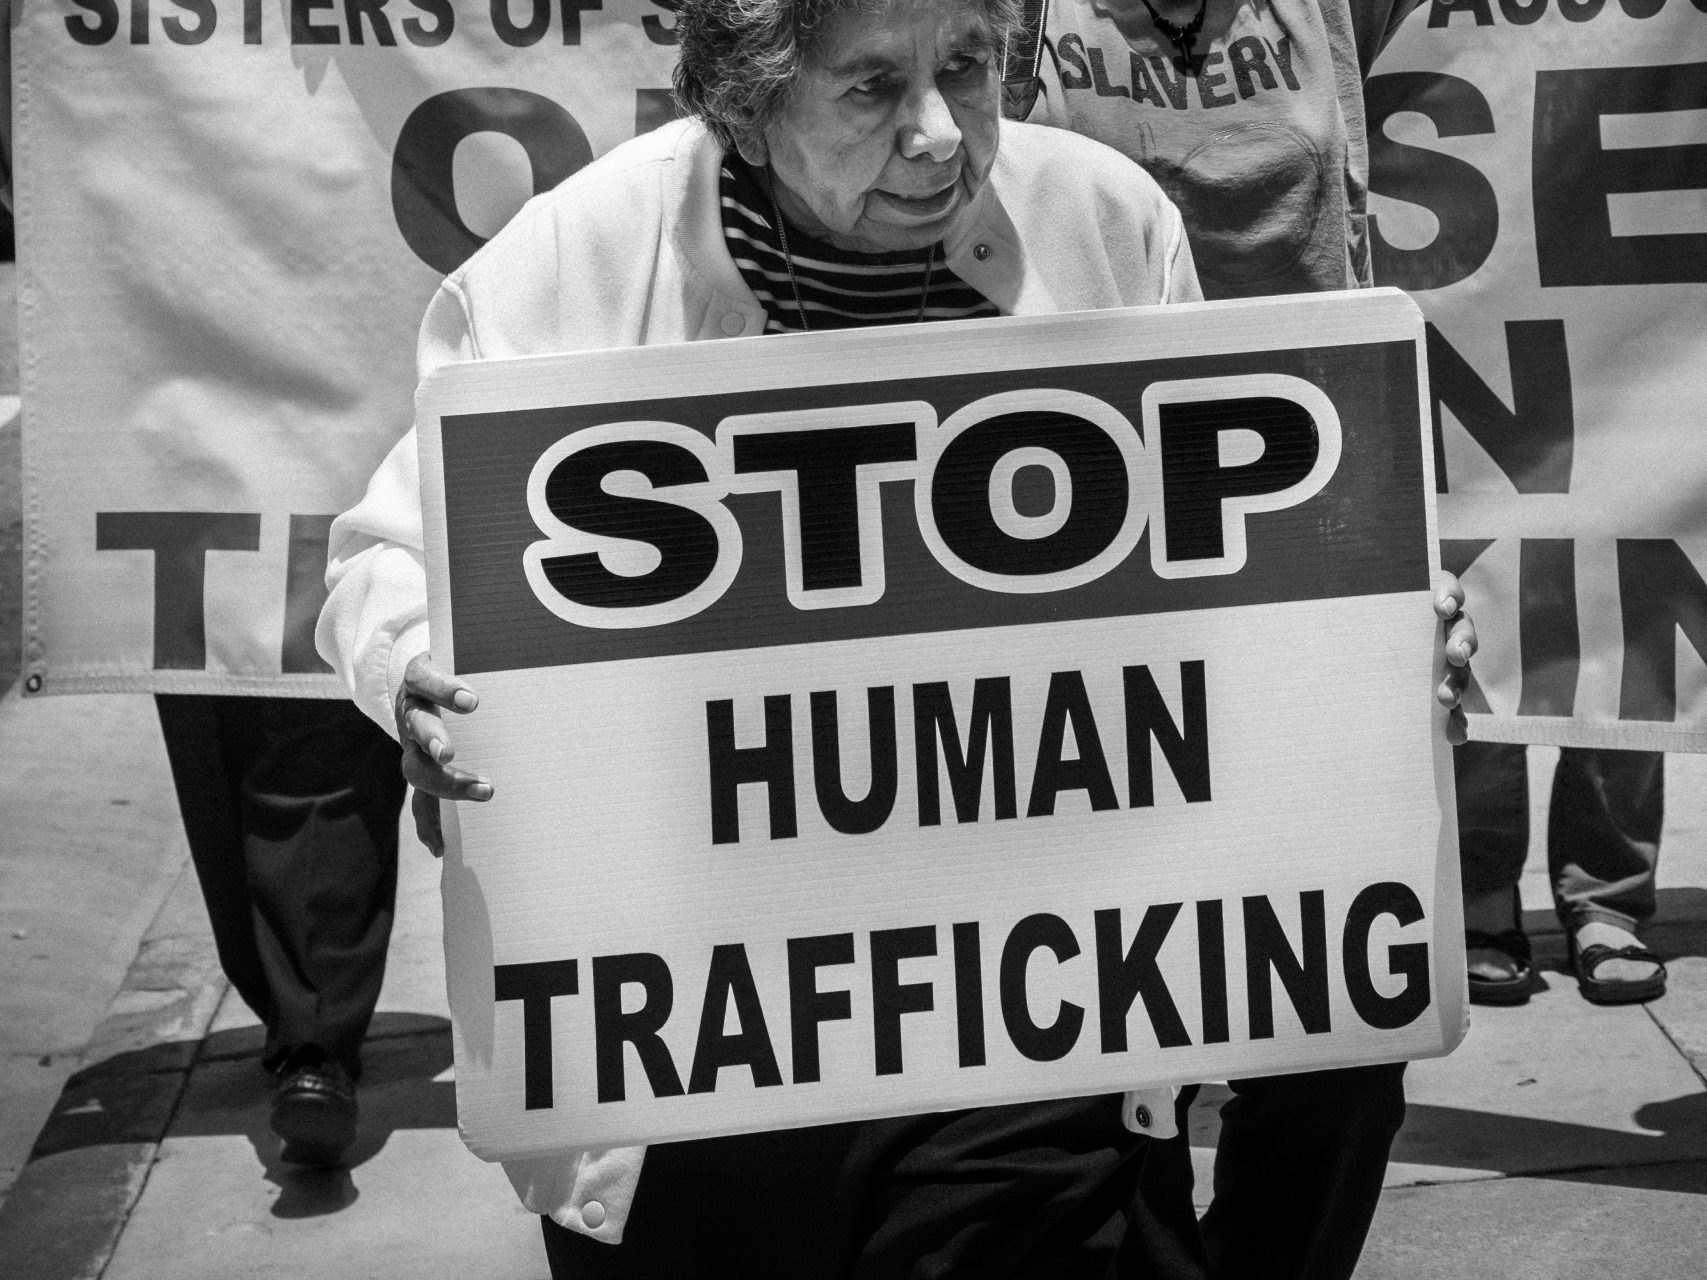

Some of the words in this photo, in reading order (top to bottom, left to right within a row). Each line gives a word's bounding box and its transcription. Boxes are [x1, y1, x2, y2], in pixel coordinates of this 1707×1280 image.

[1057, 32, 1302, 110] SLAVERY
[523, 373, 1342, 628] STOP
[705, 659, 1212, 844] HUMAN
[494, 881, 1431, 1110] TRAFFICKING
